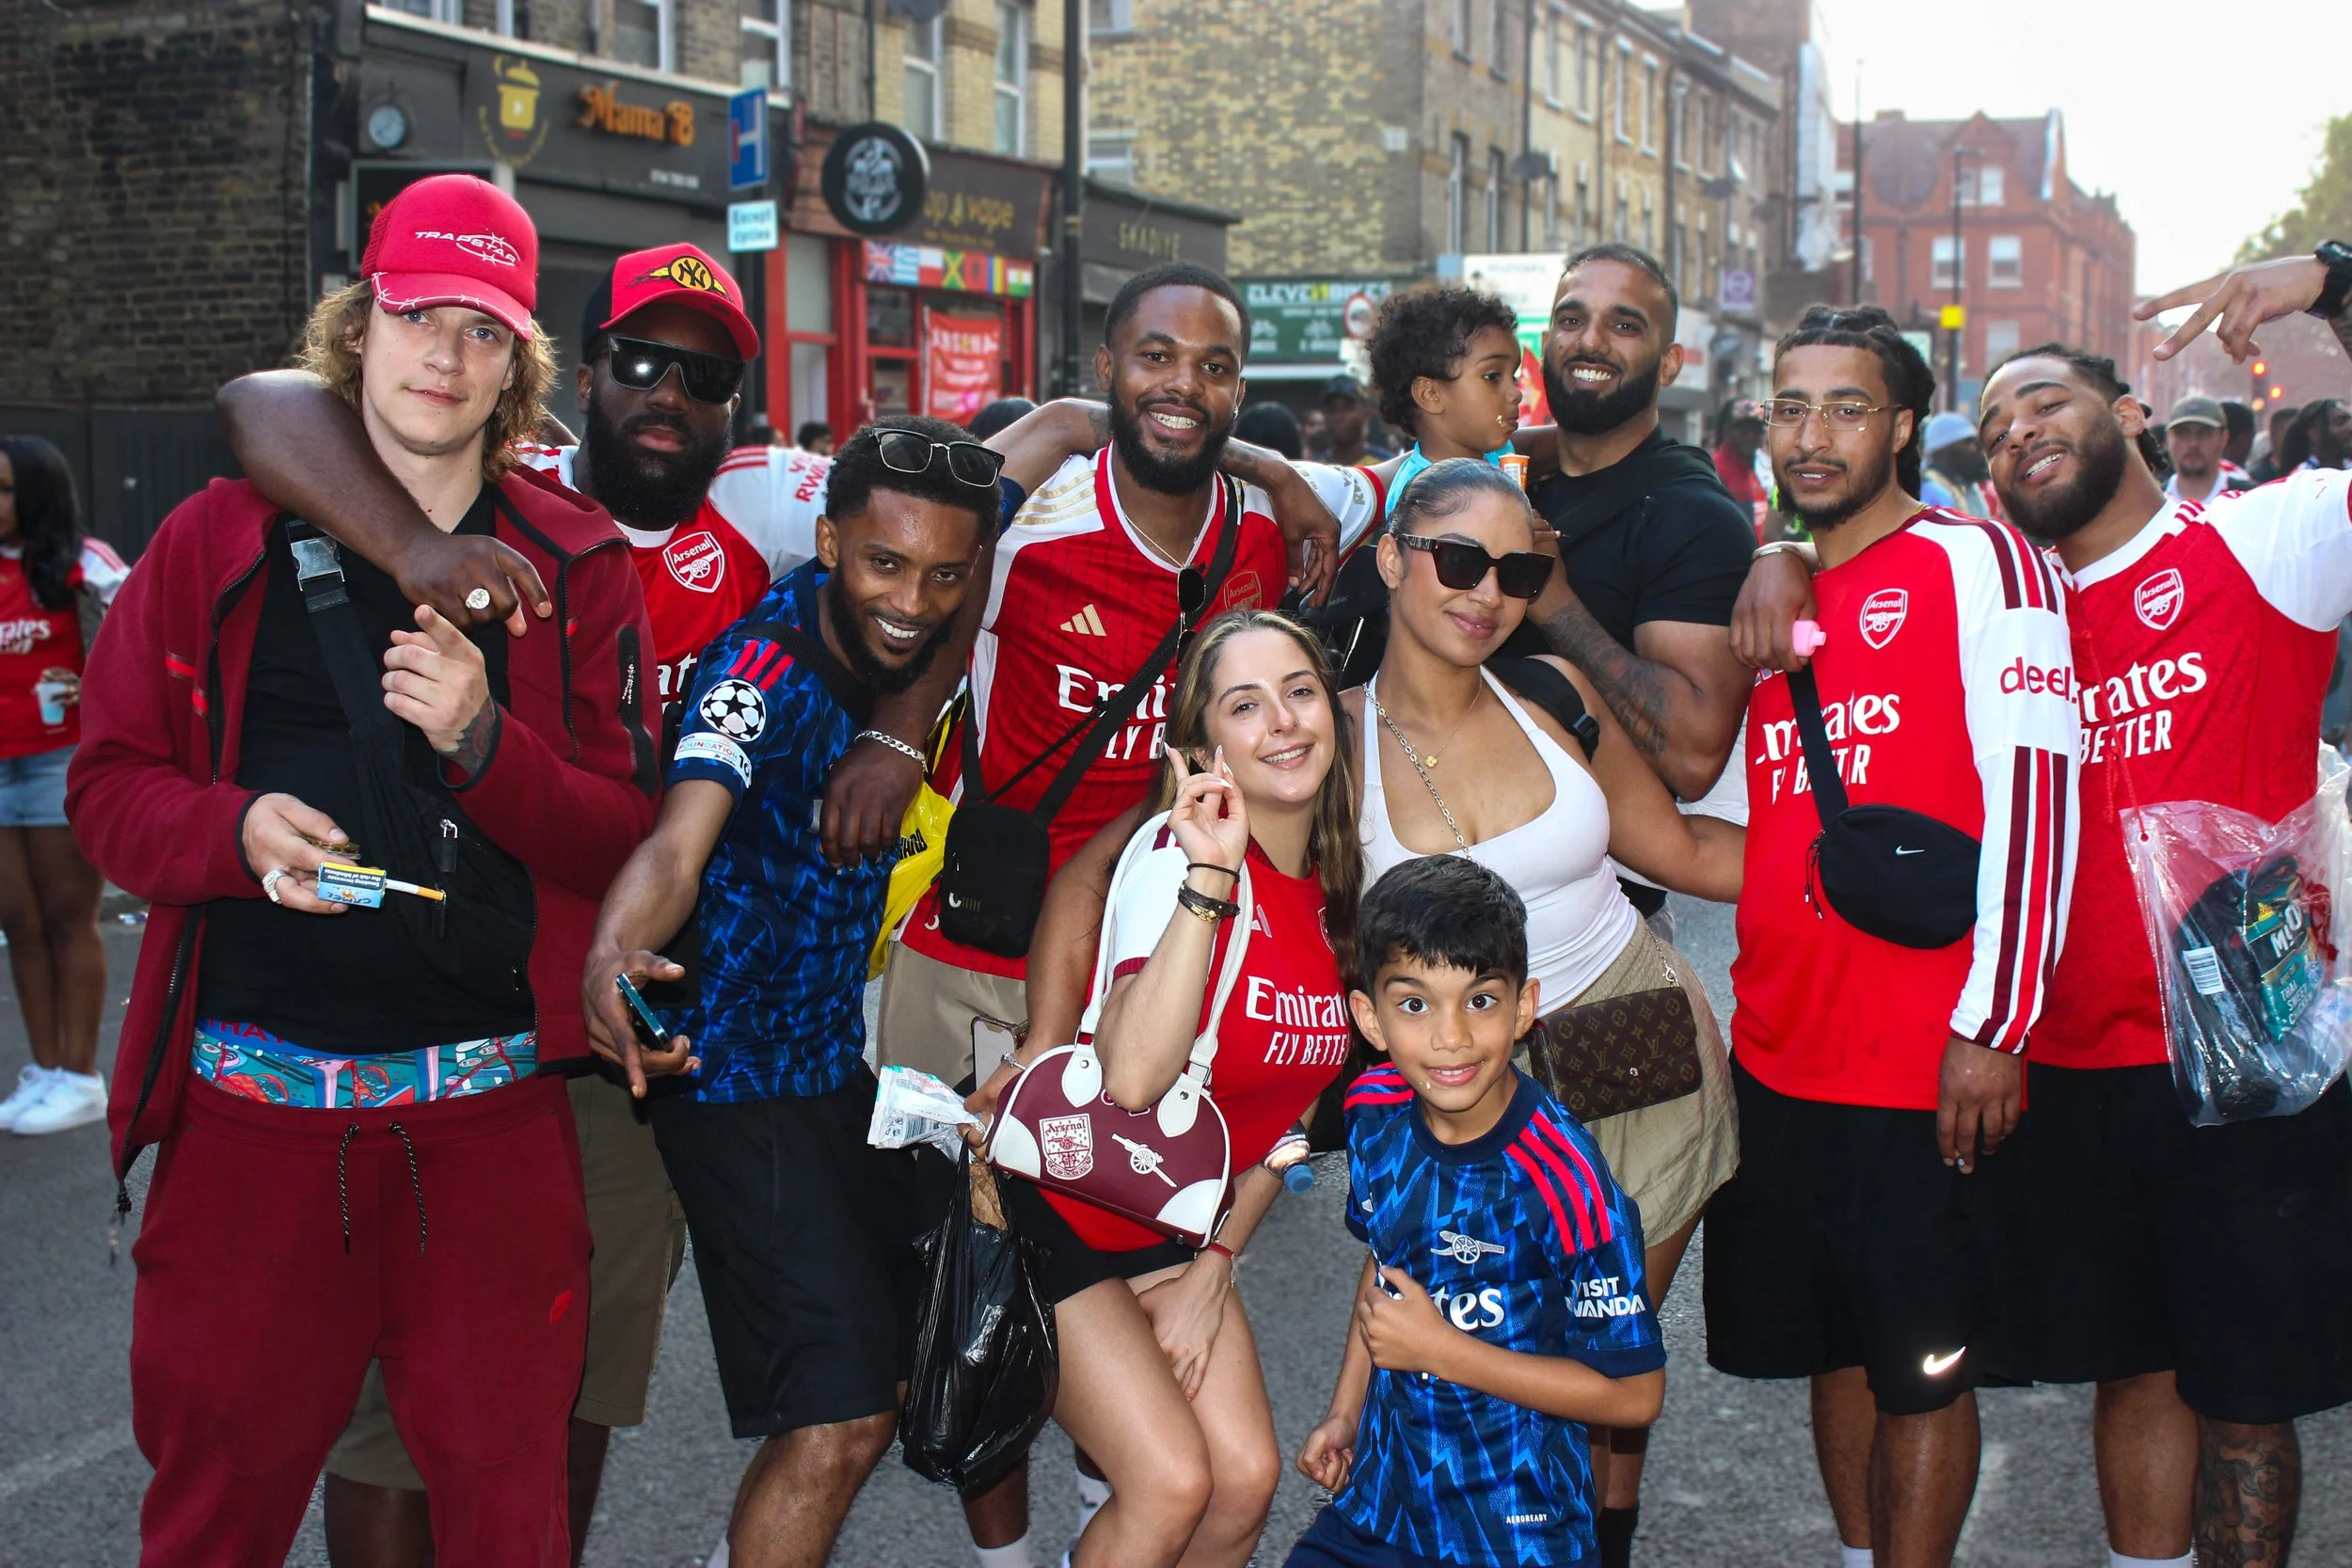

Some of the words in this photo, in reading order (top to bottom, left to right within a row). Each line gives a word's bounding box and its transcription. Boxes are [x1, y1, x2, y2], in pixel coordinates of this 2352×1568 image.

[415, 230, 516, 263] TRAPSTAR
[673, 538, 712, 564] Arsenal
[1228, 579, 1255, 599] Arsenal
[2140, 575, 2175, 601] Arsenal
[1869, 597, 1901, 610] Arsenal
[2074, 651, 2207, 724] rates
[677, 739, 738, 760] FOUNDATION
[324, 868, 352, 879] blindness
[326, 875, 355, 884] increases
[354, 878, 380, 888] Smoking
[326, 891, 373, 904] CAMEL
[1246, 975, 1349, 1027] Emirat
[1263, 1031, 1299, 1065] FLY
[1299, 1033, 1349, 1066] BETTE
[1045, 1117, 1087, 1136] Arsenal
[1570, 1275, 1620, 1298] VISIT
[1565, 1293, 1646, 1318] WANDA
[1506, 1513, 1548, 1525] AEROREADY
